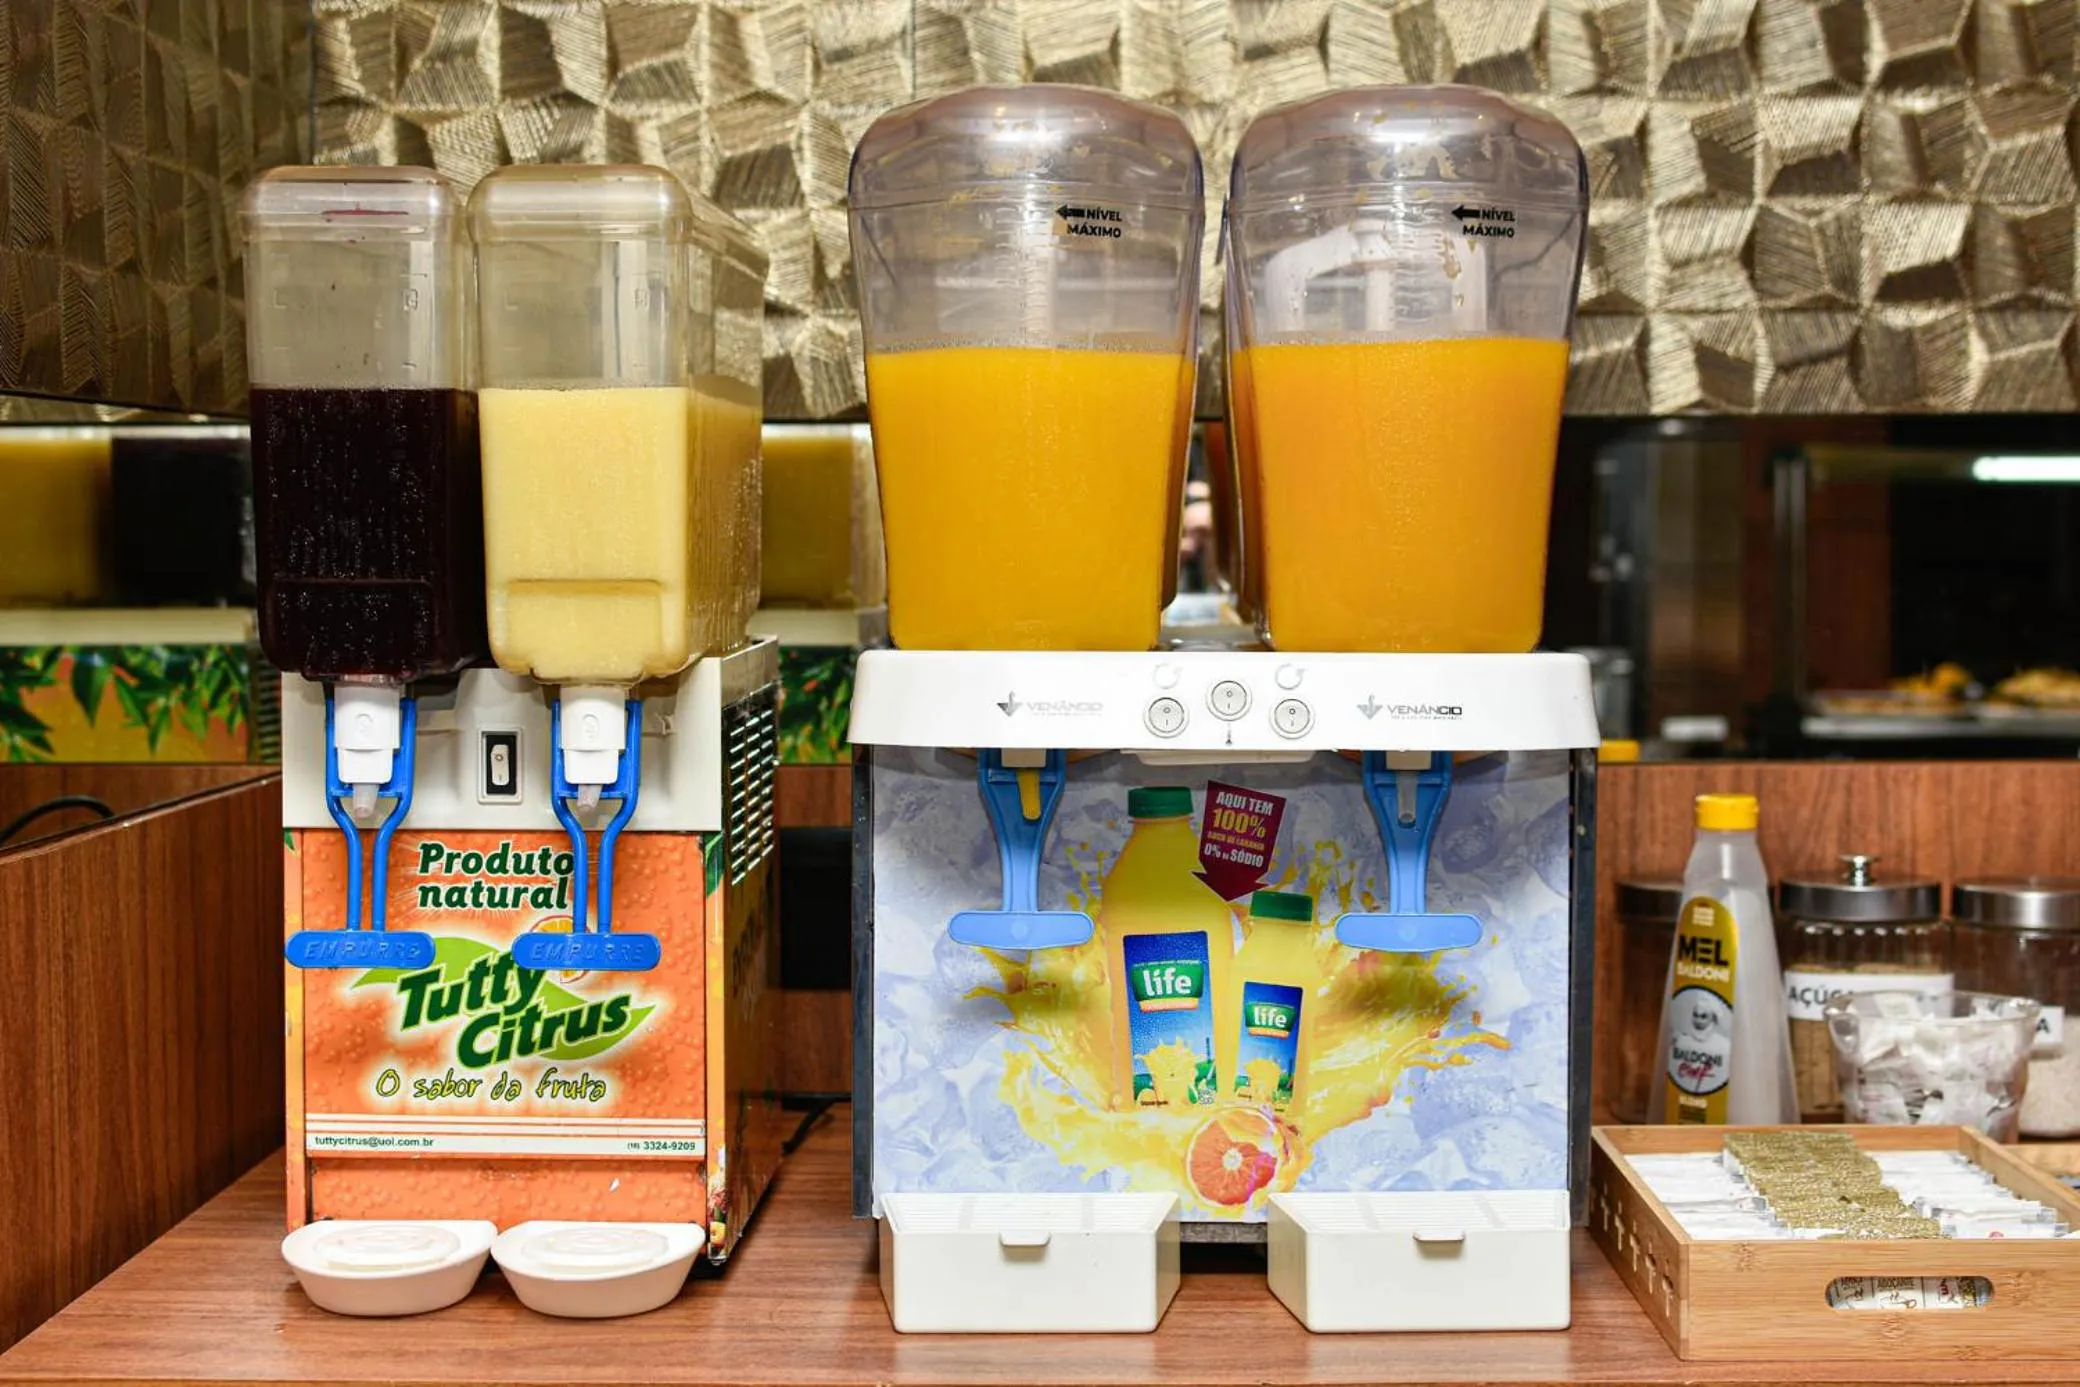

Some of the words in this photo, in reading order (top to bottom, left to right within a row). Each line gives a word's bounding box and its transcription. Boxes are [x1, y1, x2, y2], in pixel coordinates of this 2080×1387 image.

[1086, 206, 1122, 222] NÍVEL
[1481, 207, 1516, 222] NÍVEL
[1067, 222, 1121, 238] MÁXIMO
[1463, 222, 1515, 238] MÁXIMO
[1216, 791, 1246, 809] AQUI
[1249, 798, 1273, 815] TEM
[1213, 808, 1266, 837] 100%
[419, 842, 574, 876] Produto
[1204, 843, 1221, 857] 0%
[418, 877, 568, 909] natural
[532, 942, 645, 962] EMPURRE
[1679, 934, 1729, 968] MEL
[398, 953, 545, 1029] Tutty
[1143, 967, 1192, 997] life
[1253, 1006, 1288, 1028] life
[458, 995, 630, 1069] Citrus
[376, 1069, 401, 1098] O
[413, 1068, 483, 1099] sabor
[491, 1070, 522, 1100] da
[536, 1067, 607, 1101] fruta
[315, 1136, 434, 1147] tuttycitrus@uol.com.br
